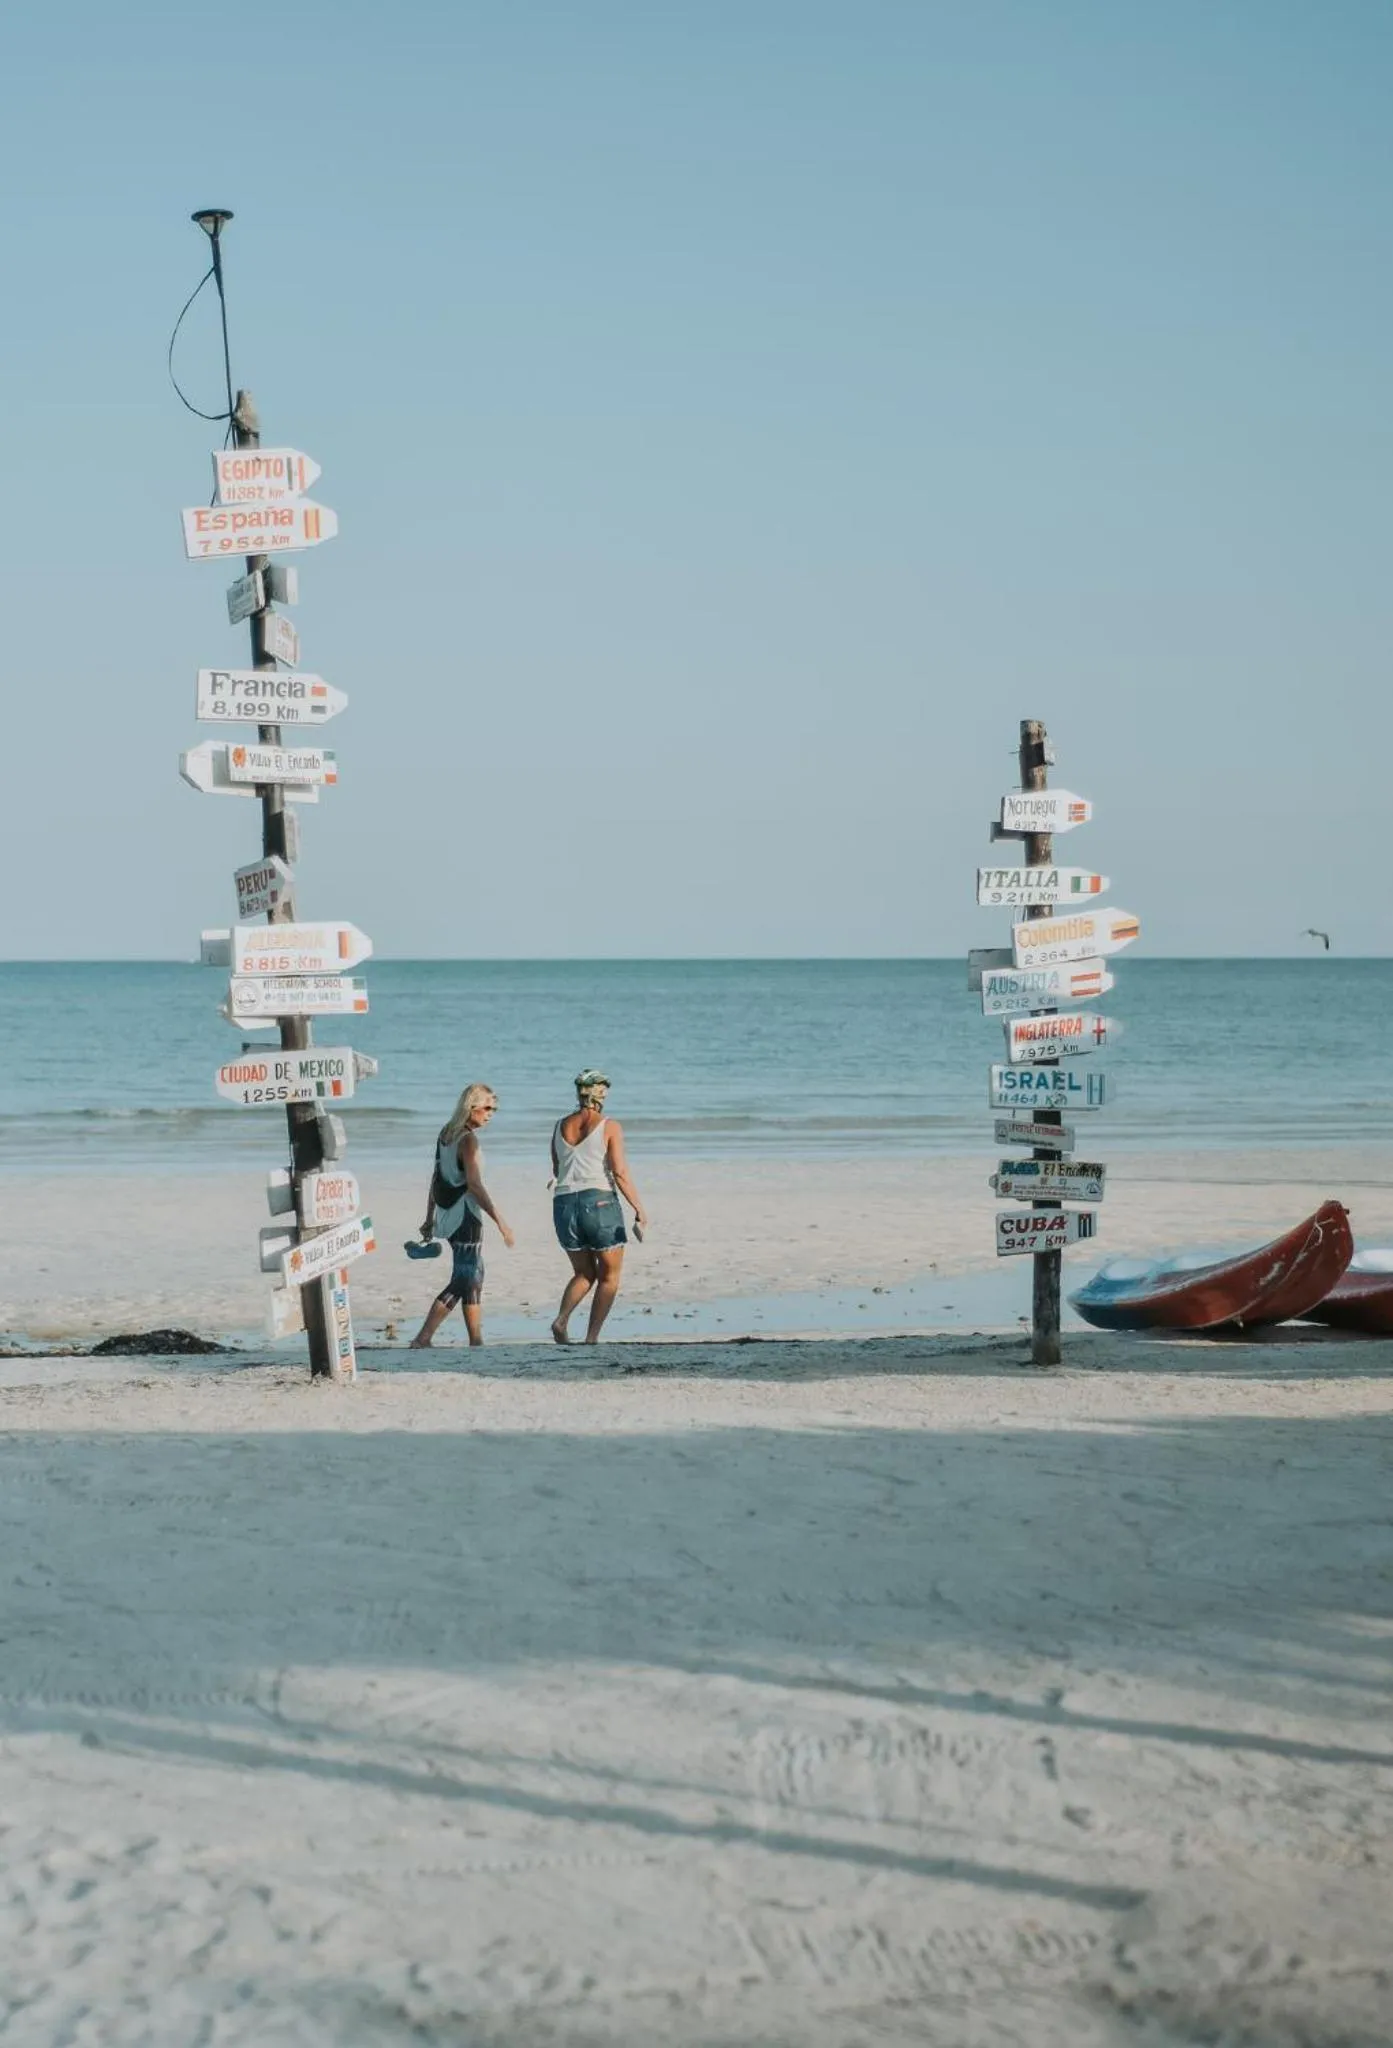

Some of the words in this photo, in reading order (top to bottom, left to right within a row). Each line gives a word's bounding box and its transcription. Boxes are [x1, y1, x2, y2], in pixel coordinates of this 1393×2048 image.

[222, 457, 284, 482] EGIPTO
[193, 506, 294, 533] España
[210, 672, 306, 698] Francia
[276, 705, 299, 720] Km
[238, 868, 269, 895] PERU
[983, 869, 1060, 889] ITALIA
[1038, 890, 1060, 901] Km
[1016, 917, 1095, 949] Colombia
[298, 956, 323, 970] Km
[986, 971, 1061, 997] AUSTRIA
[1014, 1016, 1083, 1046] INGLATERRA
[220, 1063, 268, 1084] CIUDAD
[275, 1062, 292, 1080] DE
[299, 1059, 344, 1079] MEXICO
[998, 1070, 1083, 1092] ISRAEL
[243, 1086, 289, 1104] 1255
[1000, 1214, 1068, 1234] CUBA
[1004, 1237, 1038, 1250] 947
[1045, 1235, 1068, 1248] Km
